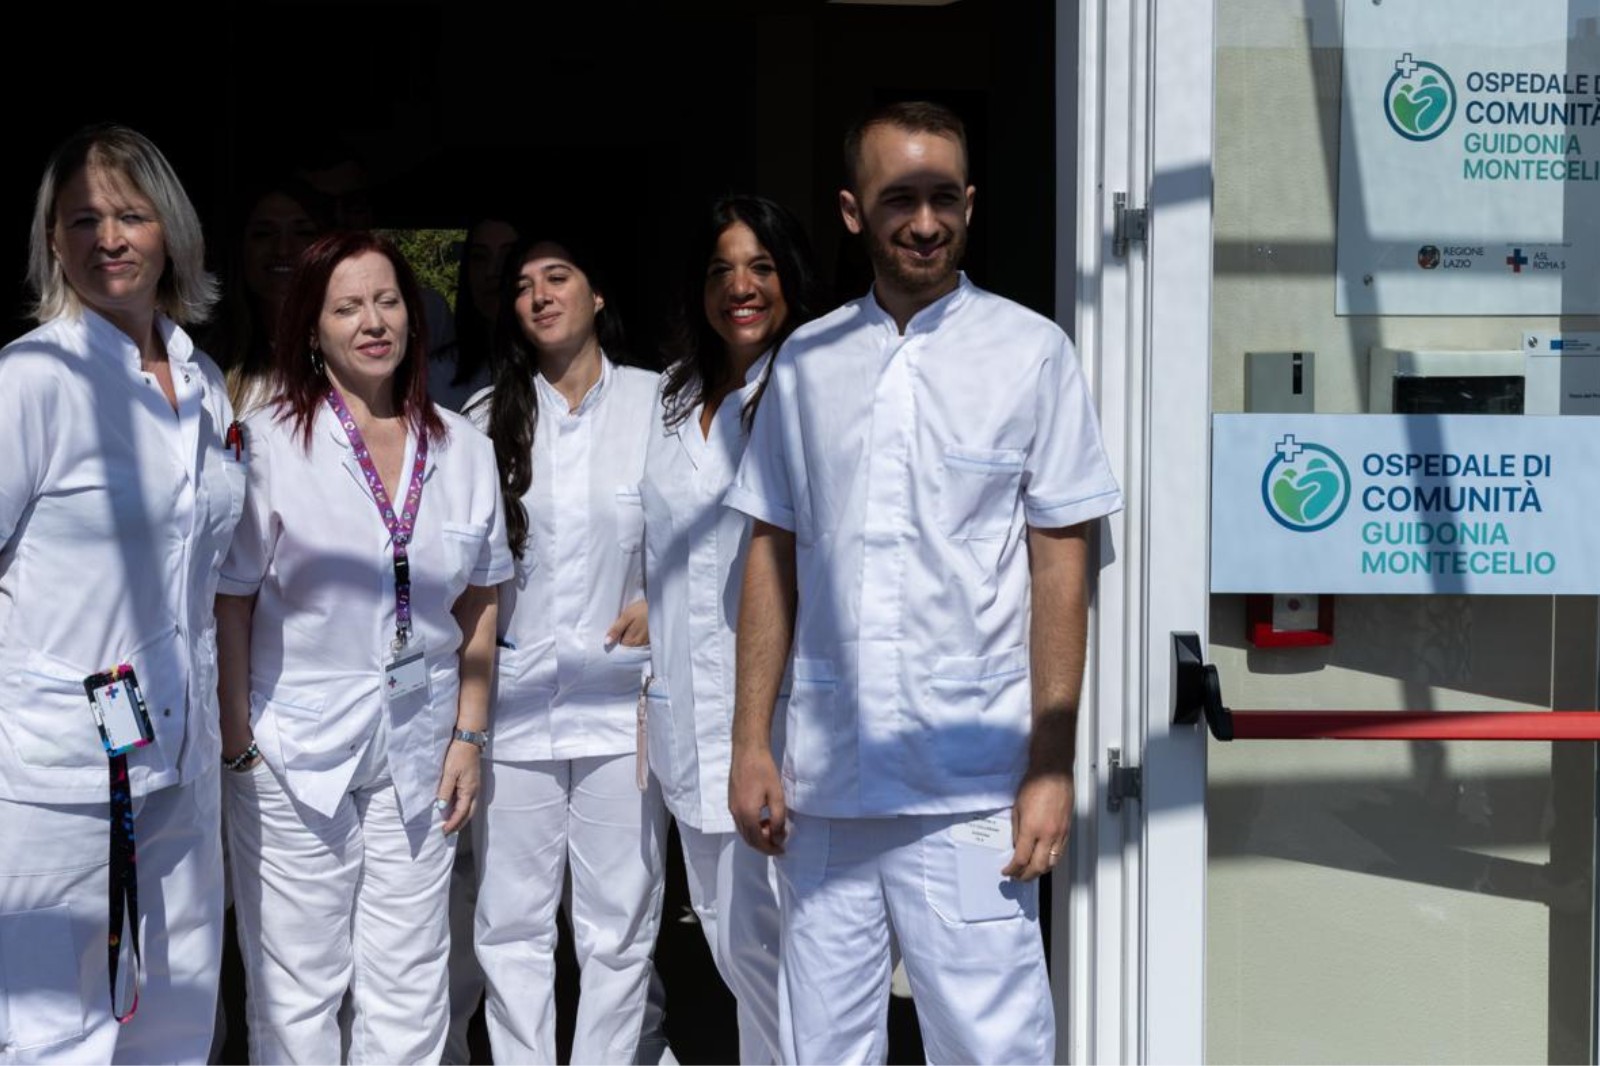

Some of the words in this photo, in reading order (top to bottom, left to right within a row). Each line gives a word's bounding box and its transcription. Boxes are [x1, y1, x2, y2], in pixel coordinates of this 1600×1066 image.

[1466, 72, 1588, 95] OSPEDALE
[1464, 133, 1582, 155] GUIDONIA
[1443, 247, 1484, 256] REGIONE
[1443, 259, 1471, 268] LAZIO
[1533, 261, 1559, 270] ROMA
[1362, 453, 1515, 477] OSPEDALE
[1524, 454, 1551, 477] DI
[1362, 480, 1543, 512] COMUNITÀ
[1361, 521, 1510, 545] GUIDONIA
[1361, 551, 1556, 575] MONTECELIO
